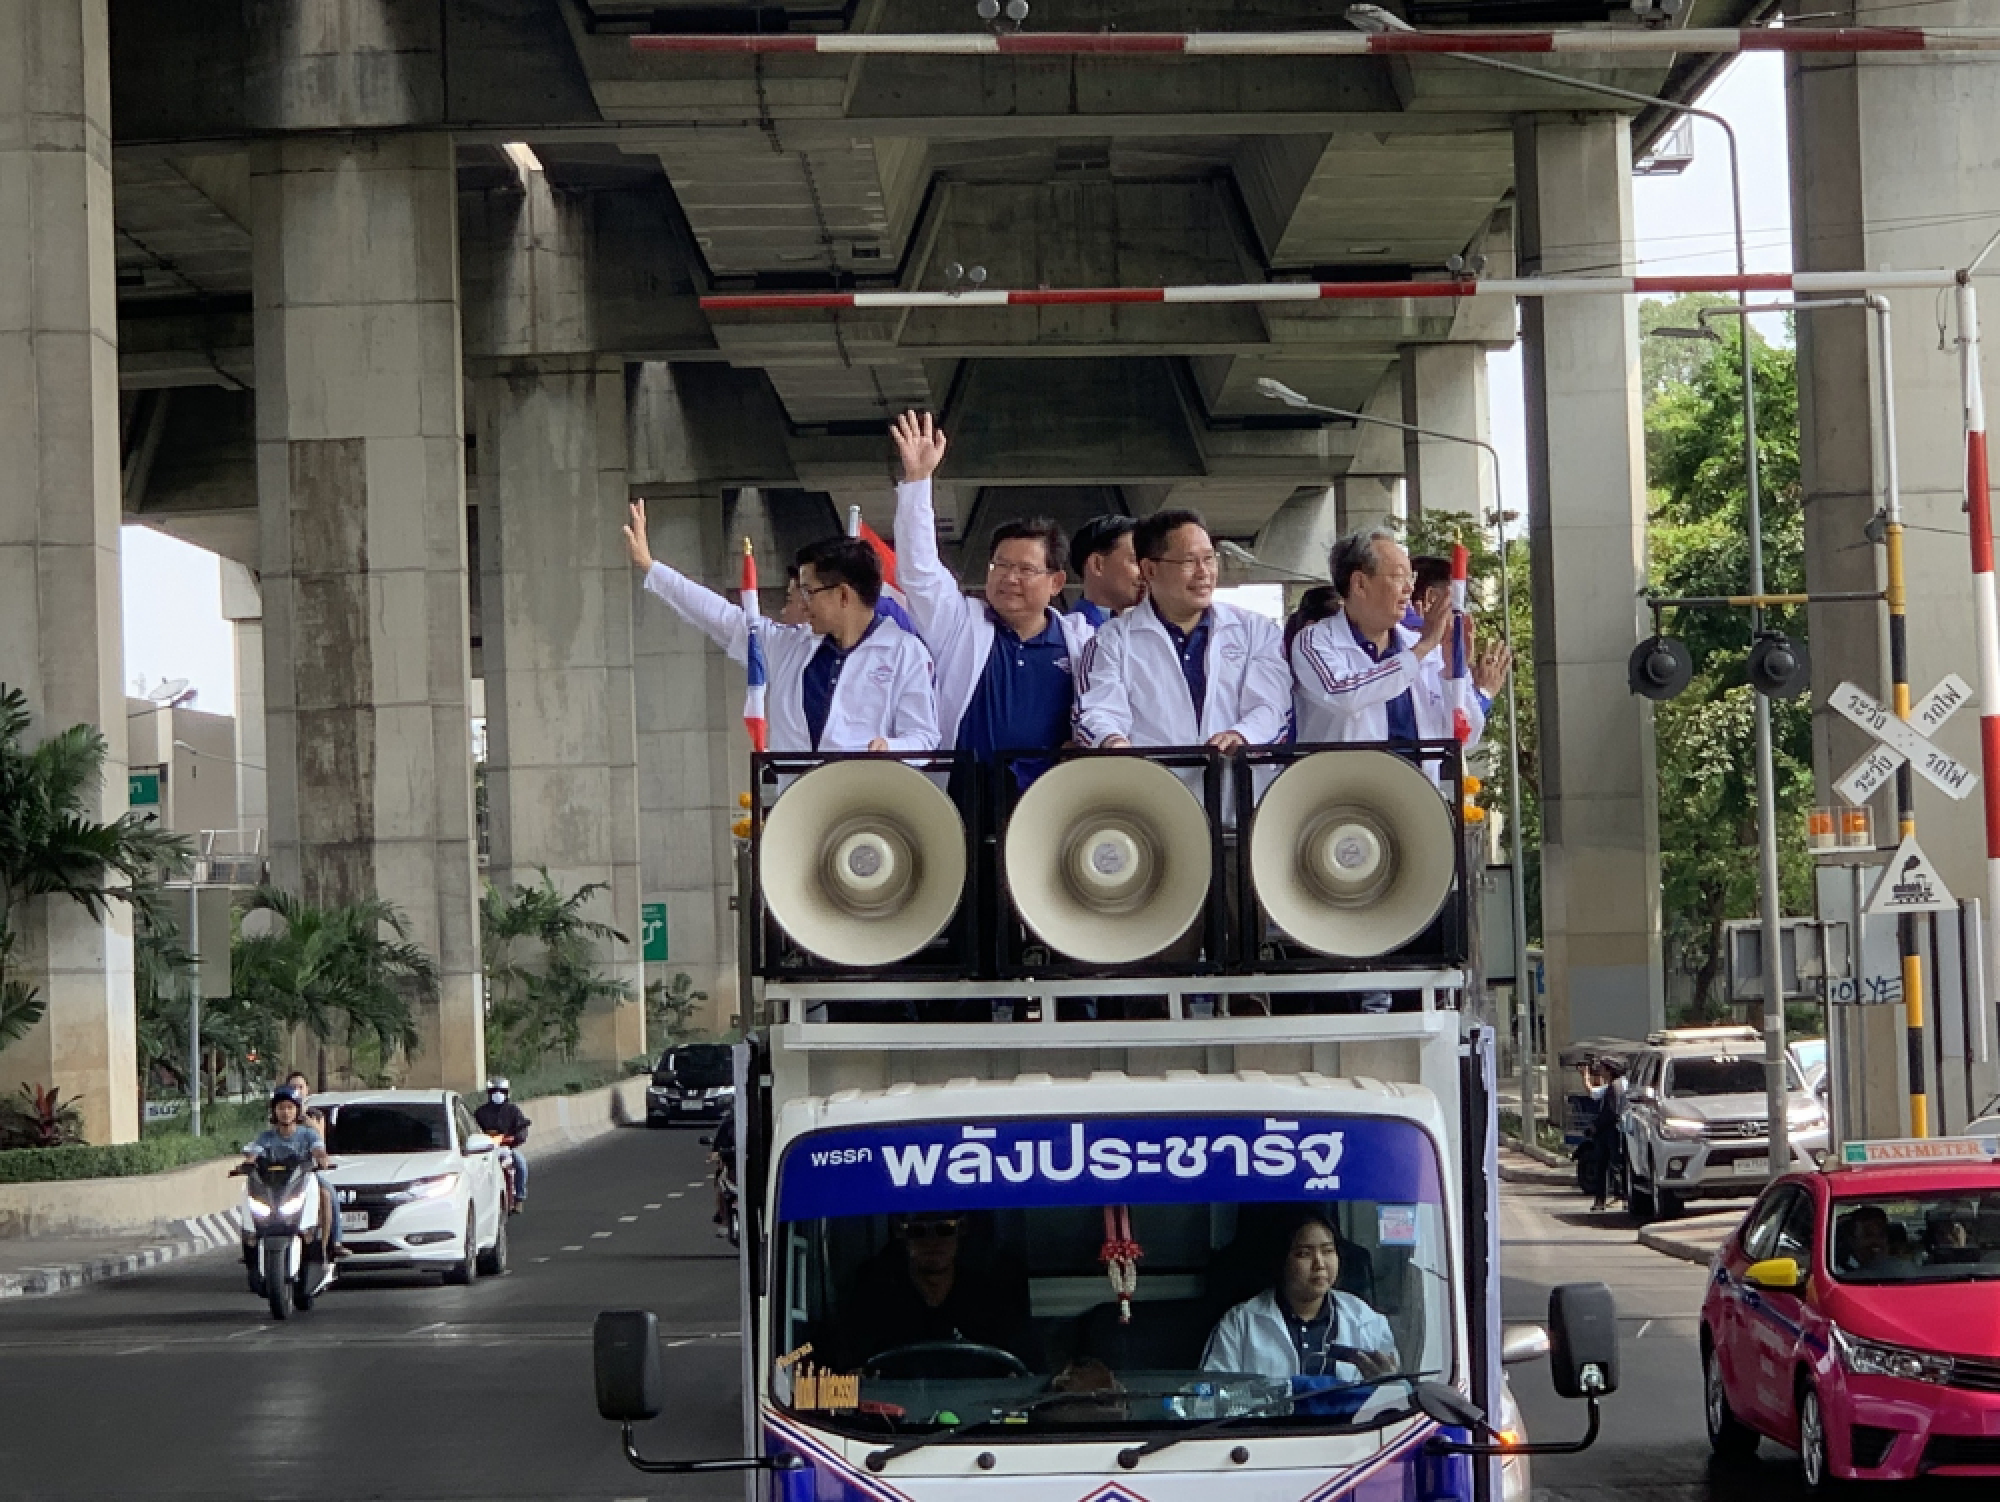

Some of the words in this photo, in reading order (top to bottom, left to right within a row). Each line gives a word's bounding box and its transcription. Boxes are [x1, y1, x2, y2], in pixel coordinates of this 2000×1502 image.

[1847, 695, 1888, 731] ระวัง
[1925, 753, 1969, 789] รถไฟ
[1853, 755, 1893, 792] ระวัง
[1922, 683, 1963, 725] รถไฟ
[811, 1148, 872, 1167] พรรค
[881, 1117, 1345, 1190] พลังประชารัฐ
[1868, 1142, 1980, 1159] TAXI-METER
